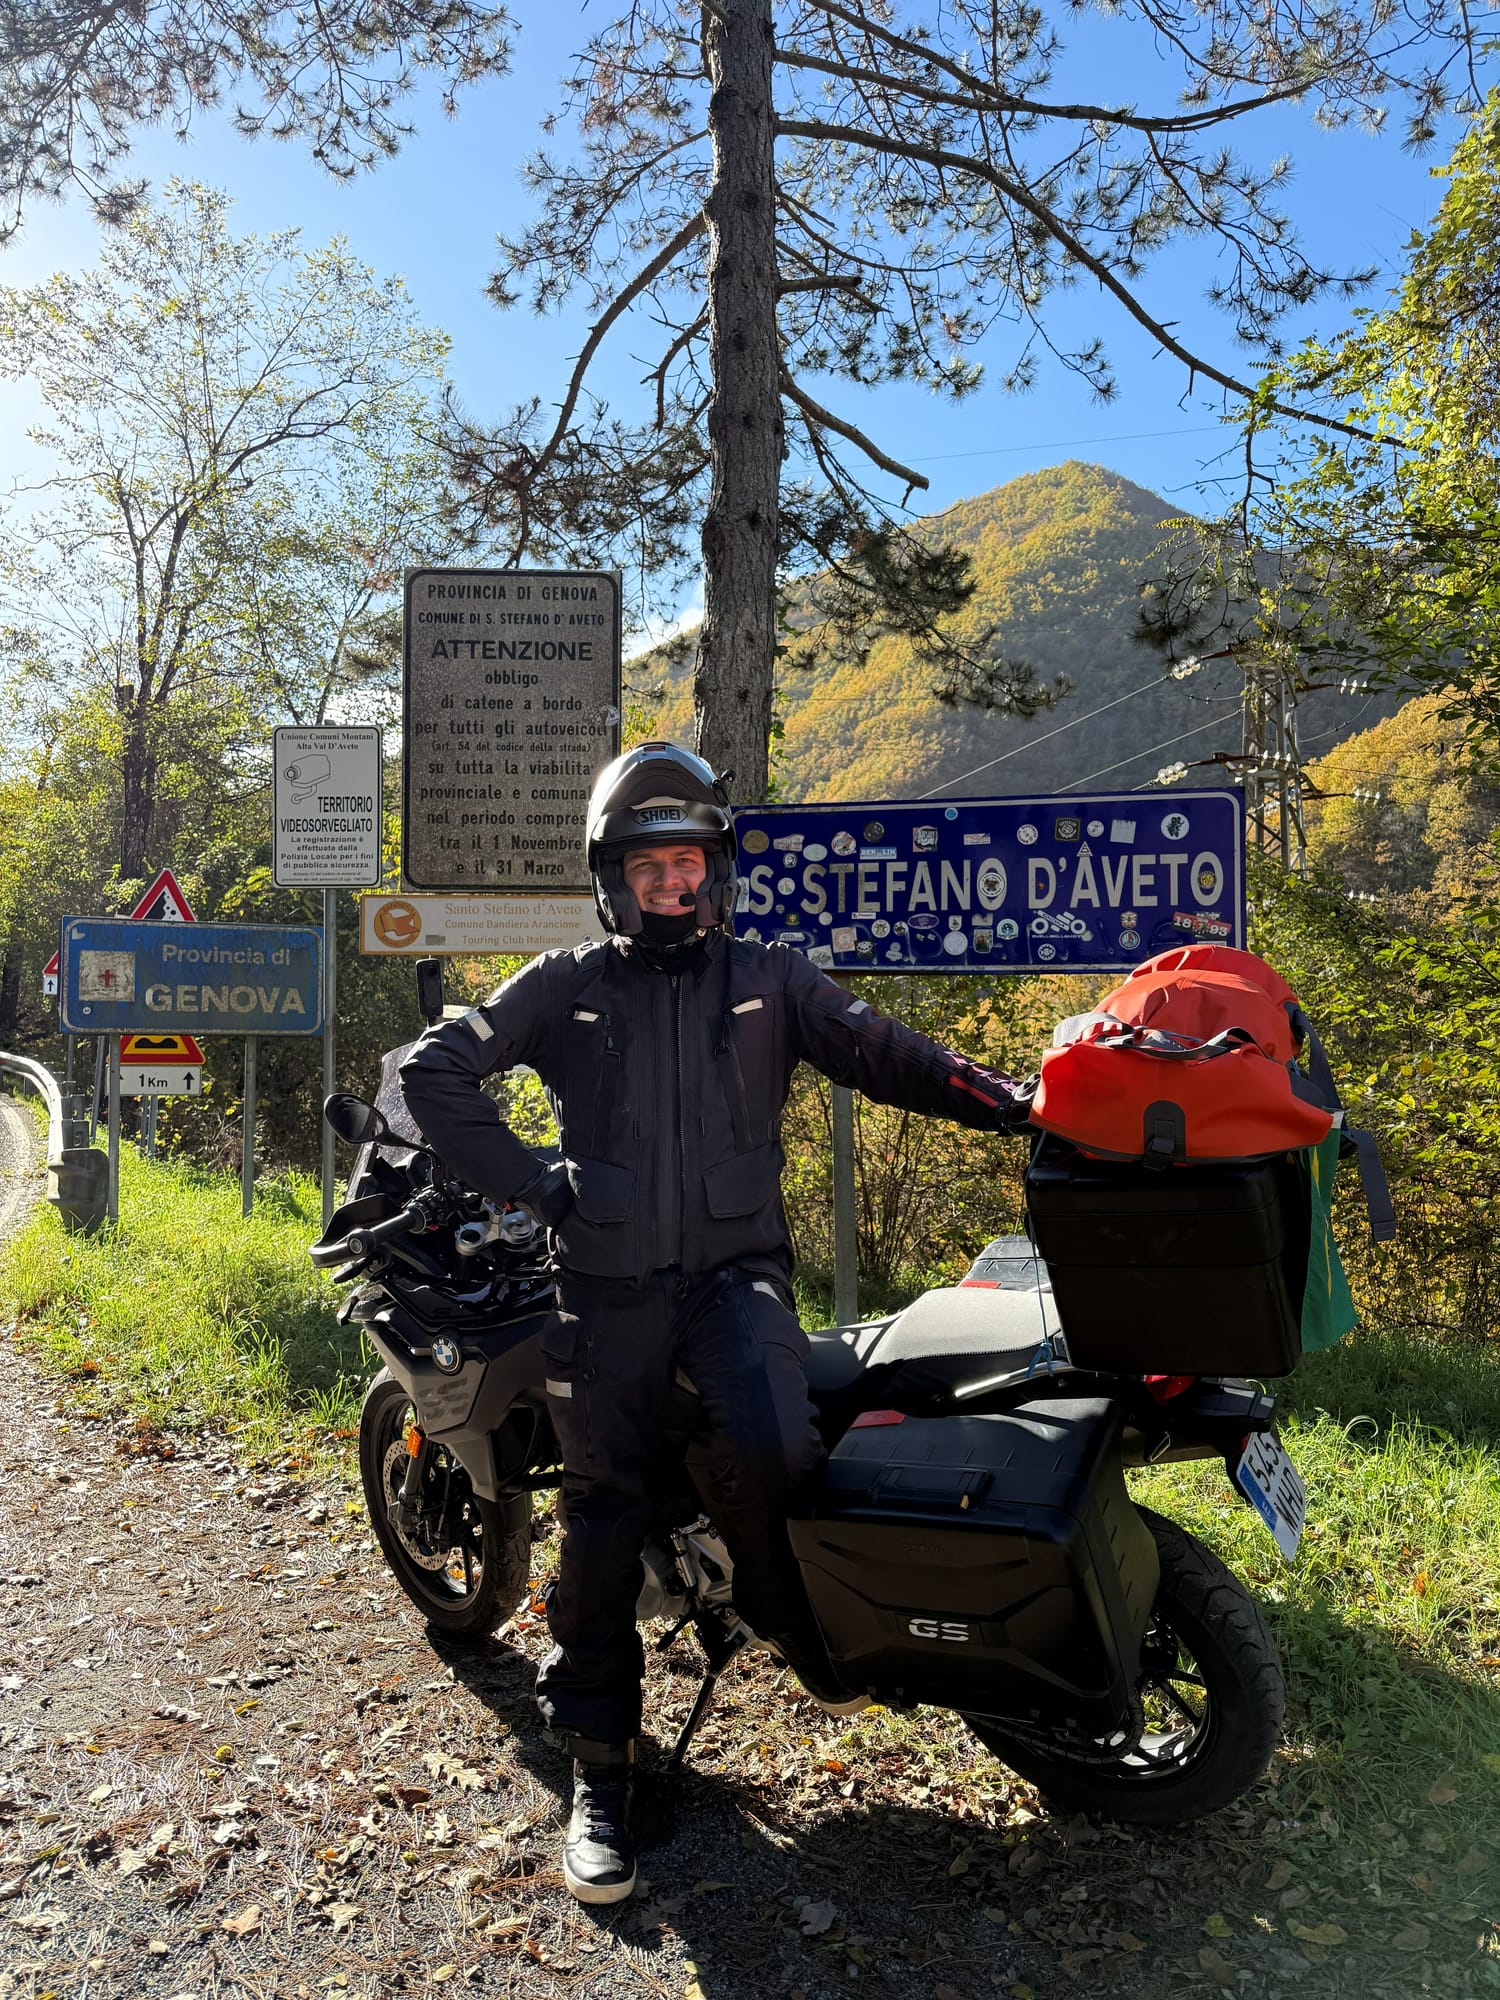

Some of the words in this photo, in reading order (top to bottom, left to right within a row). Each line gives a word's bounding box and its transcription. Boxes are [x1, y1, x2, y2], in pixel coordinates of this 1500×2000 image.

[428, 585, 506, 599] PROVINCIA
[517, 586, 531, 599] DI
[542, 586, 598, 601] GENOVA
[418, 612, 465, 624] COMUNE
[469, 613, 481, 624] DI
[486, 613, 495, 625] S.
[500, 613, 550, 625] STEFANO
[569, 614, 605, 625] AVETO
[431, 639, 593, 661] ATTENZIONE
[485, 670, 538, 688] obbligo
[441, 694, 453, 710] di
[465, 697, 513, 710] catene
[524, 699, 531, 710] a
[543, 696, 582, 711] bordo
[415, 722, 438, 737] per
[450, 720, 484, 735] tutti
[495, 720, 515, 738] gli
[525, 721, 608, 736] autoveicoli
[458, 741, 470, 751] 54
[476, 742, 489, 752] del
[496, 742, 524, 752] codice
[530, 742, 553, 752] della
[559, 742, 591, 753] strada)
[428, 763, 444, 774] su
[456, 761, 493, 774] tutta
[505, 761, 518, 775] la
[420, 785, 502, 801] provinciale
[513, 788, 521, 800] e
[531, 785, 592, 800] comunal
[318, 796, 373, 813] TERRITORIO
[427, 811, 449, 824] nel
[462, 811, 515, 827] periodo
[526, 814, 587, 828] compres
[640, 808, 680, 823] SHOEI
[280, 818, 373, 833] VIDEOSORVEGLIATO
[303, 836, 357, 844] registrazione
[440, 836, 461, 850] tra
[471, 835, 482, 849] il
[494, 836, 499, 849] 1
[511, 835, 582, 850] Novembre
[457, 864, 465, 875] e
[475, 861, 486, 875] il
[496, 860, 512, 875] 31
[524, 860, 564, 875] Marzo
[800, 857, 1007, 915] STEFANO
[1028, 851, 1224, 909] D'AVETO
[445, 903, 480, 915] Santo
[483, 903, 530, 915] Stefano
[533, 903, 582, 915] d'Aveto
[445, 920, 484, 929] Comune
[487, 919, 530, 929] Bandiera
[531, 919, 580, 929] Arancione
[462, 935, 500, 946] Touring
[503, 935, 525, 945] Club
[526, 935, 563, 945] Italiano
[162, 944, 264, 965] Provincia
[271, 947, 291, 966] di
[145, 984, 306, 1015] GENOVA
[908, 1618, 969, 1641] GS
